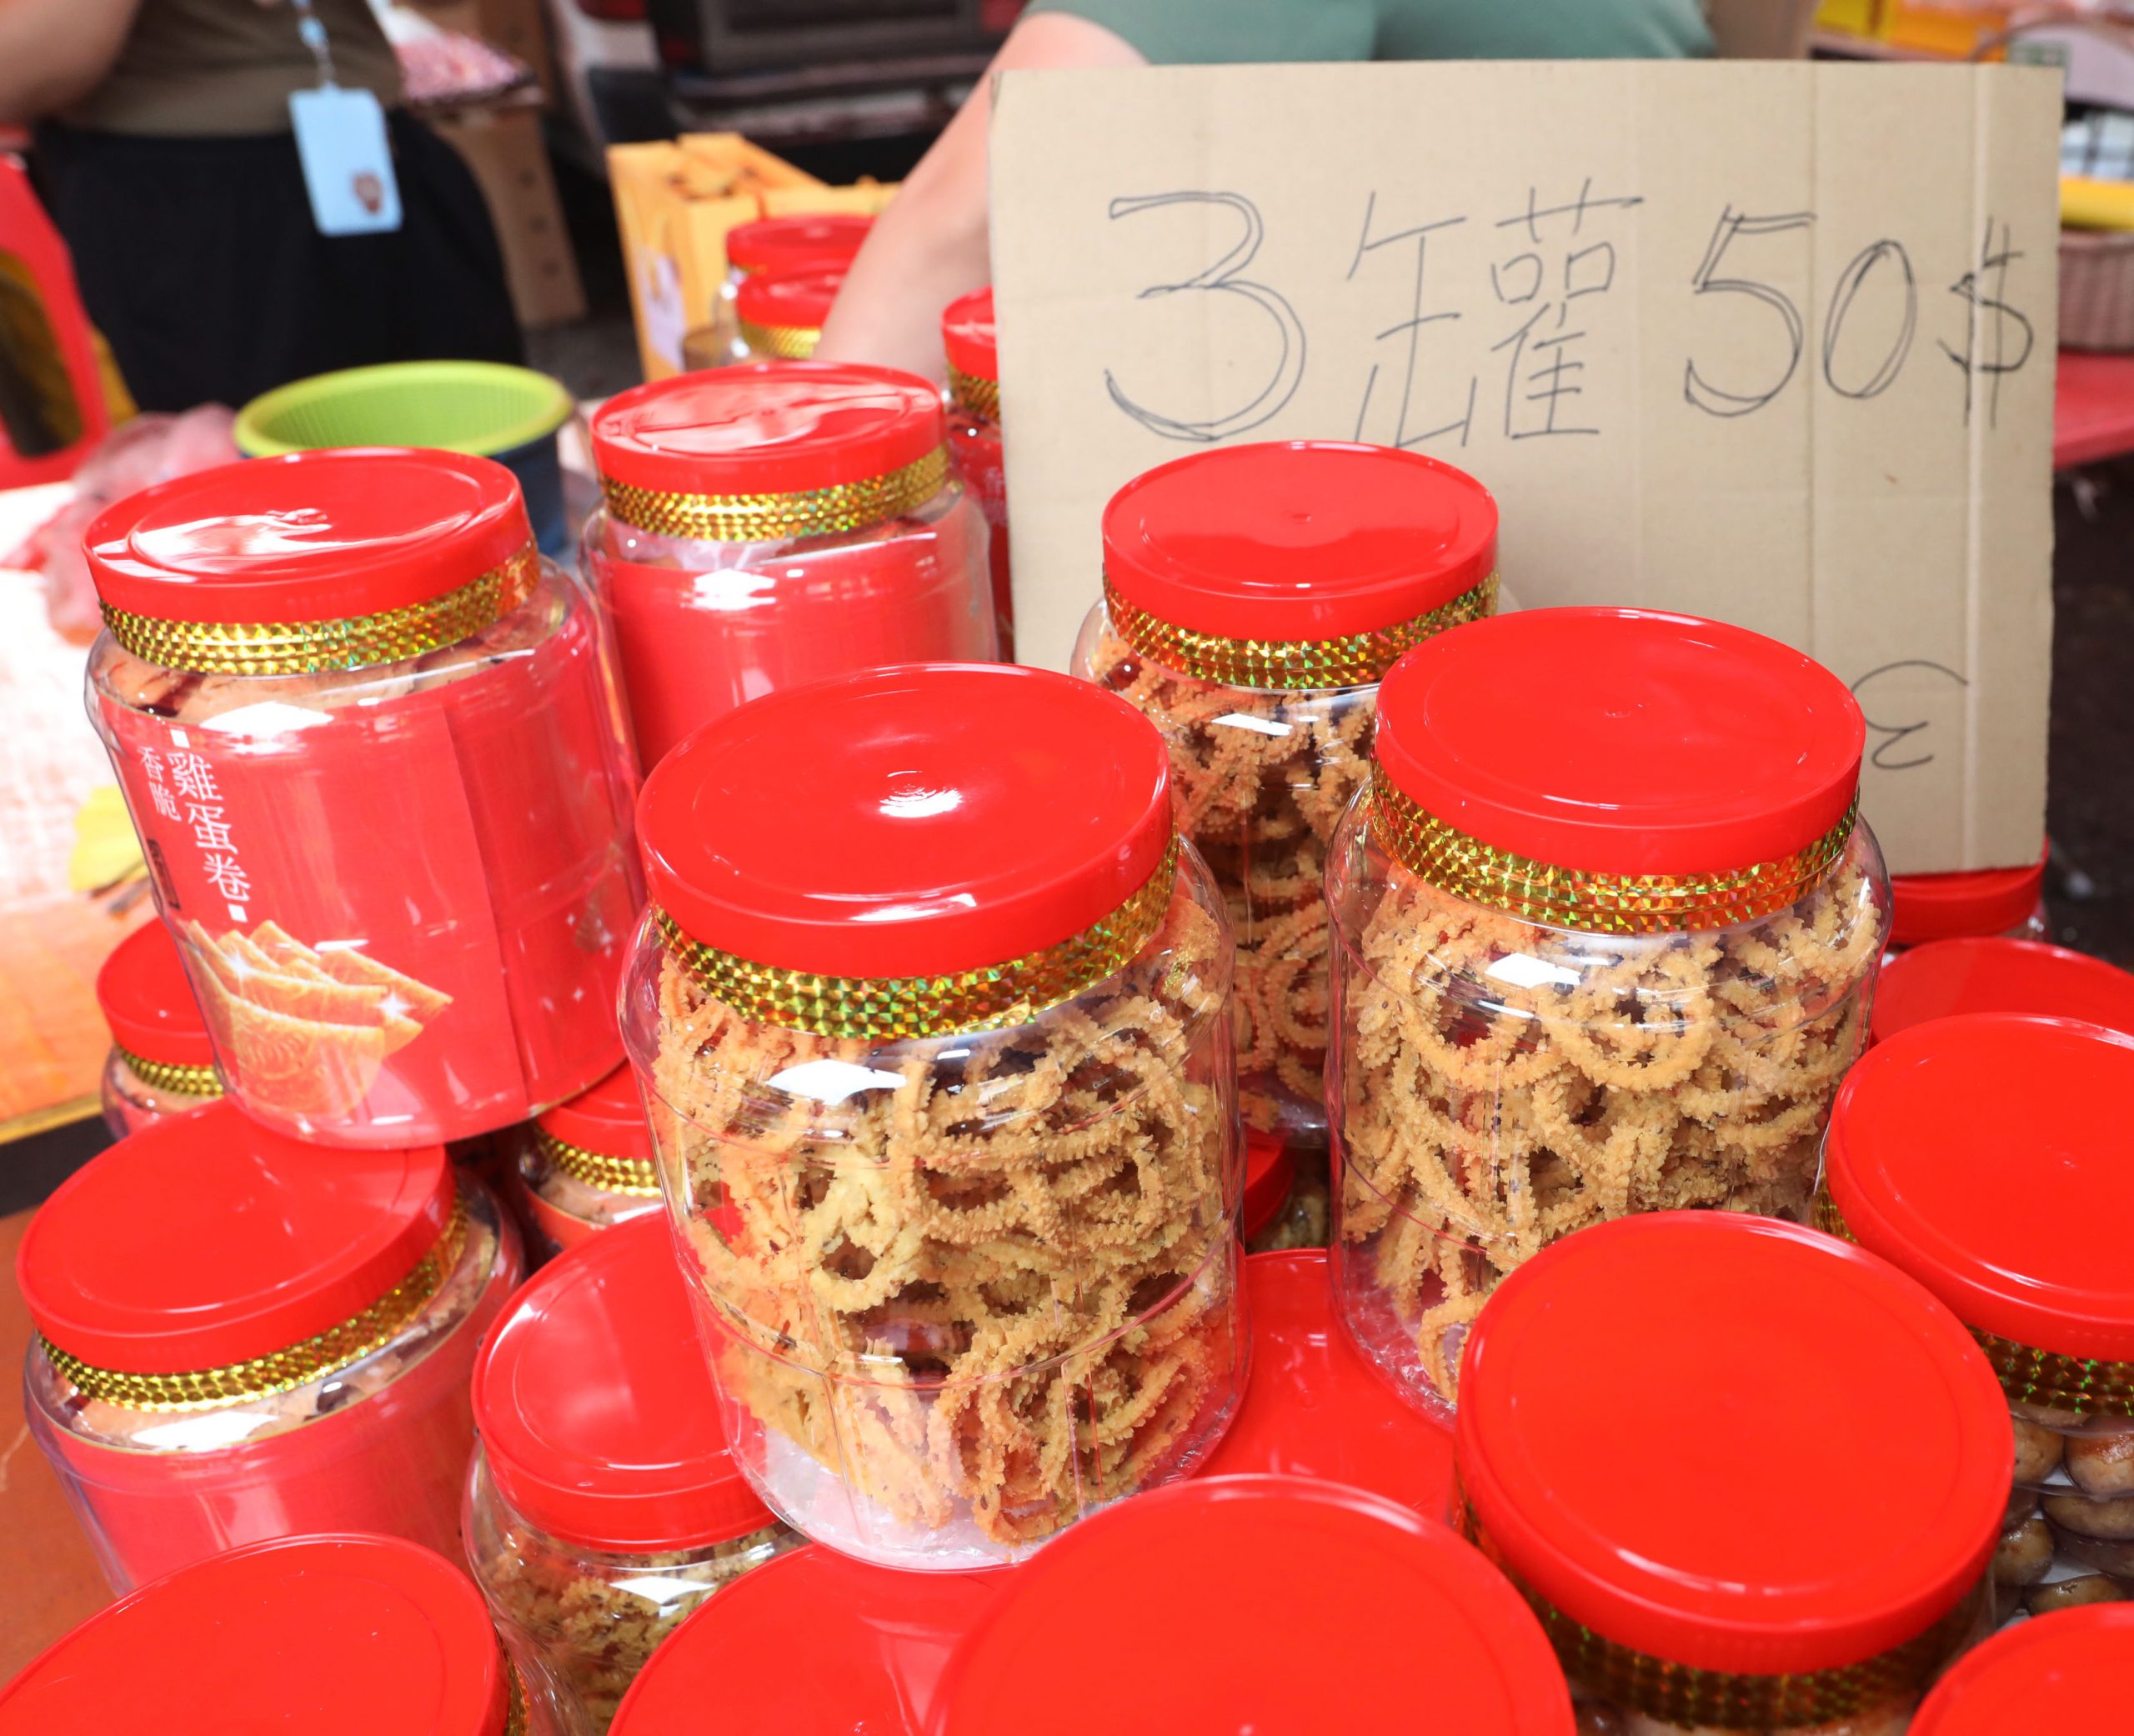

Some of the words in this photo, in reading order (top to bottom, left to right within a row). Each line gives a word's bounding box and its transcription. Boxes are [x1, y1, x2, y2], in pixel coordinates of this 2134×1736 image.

[137, 746, 182, 823] 香脆
[167, 752, 251, 903] 雞蛋卷
